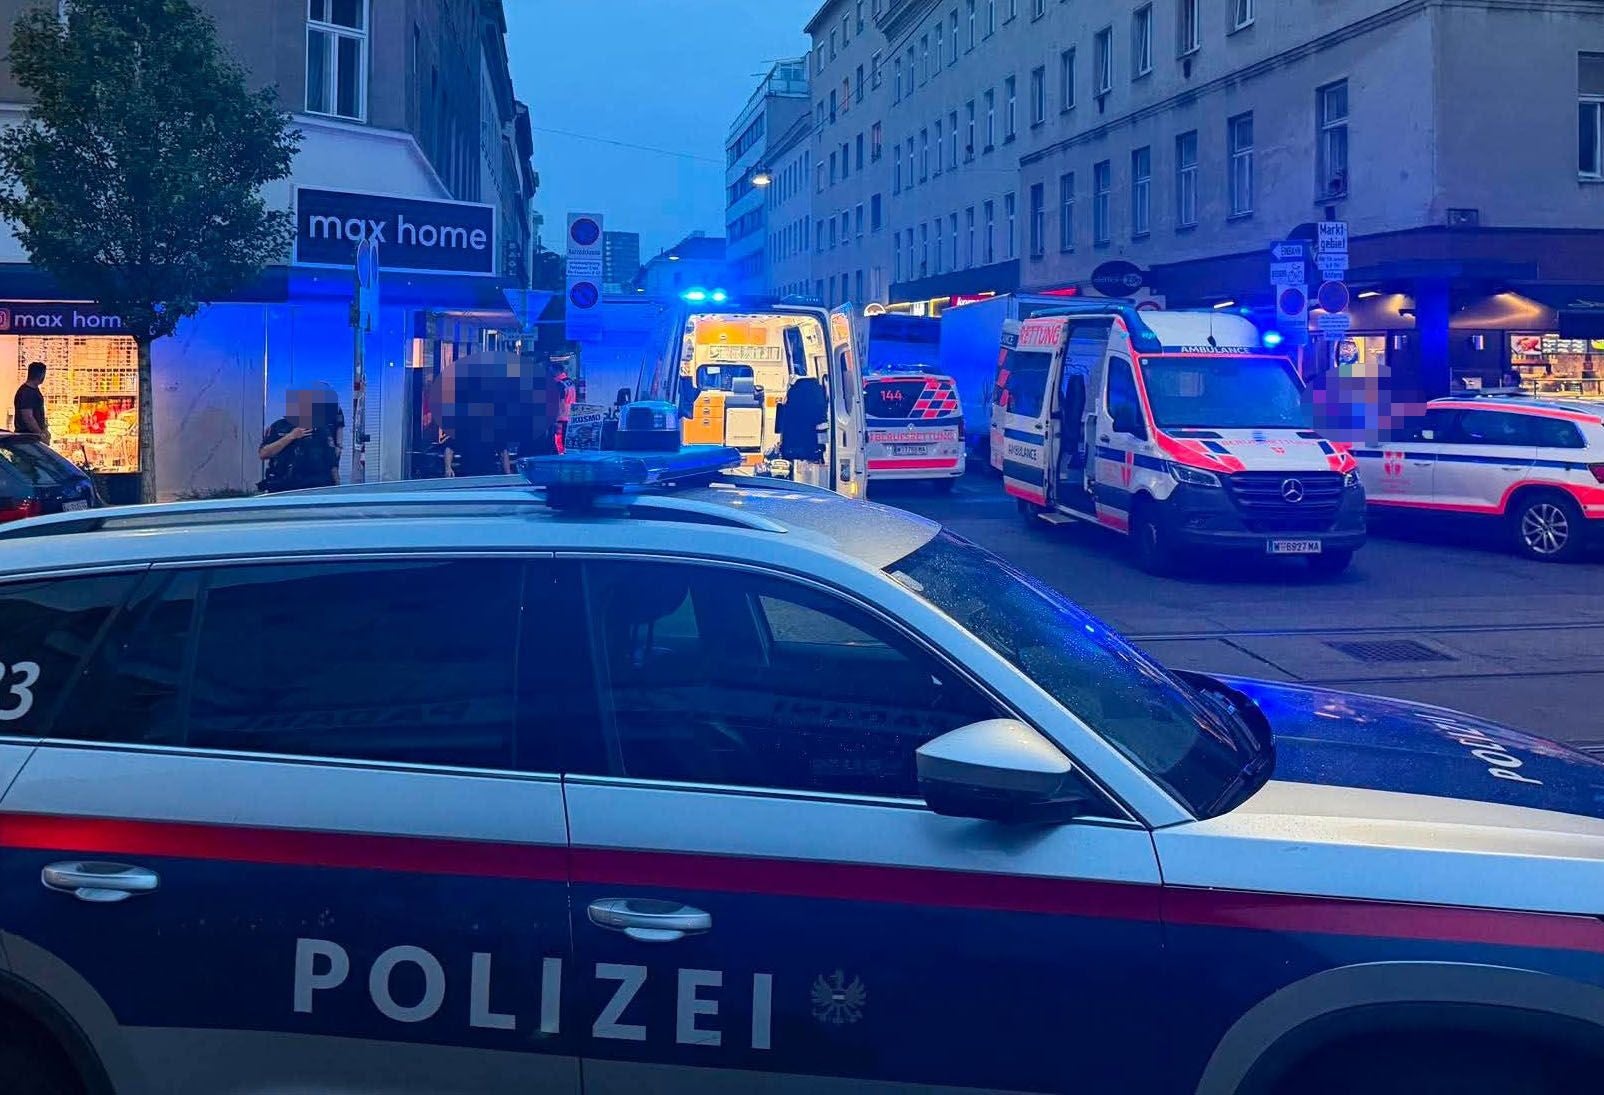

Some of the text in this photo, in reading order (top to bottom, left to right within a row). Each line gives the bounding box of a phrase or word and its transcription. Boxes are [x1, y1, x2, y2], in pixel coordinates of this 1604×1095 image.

[309, 214, 487, 250] max home
[1320, 224, 1344, 236] Markt
[1321, 238, 1345, 251] gebiet
[14, 311, 122, 328] max hom
[1180, 345, 1250, 354] AMBULANCE
[880, 390, 903, 401] 144
[293, 938, 773, 1050] POLIZEI
